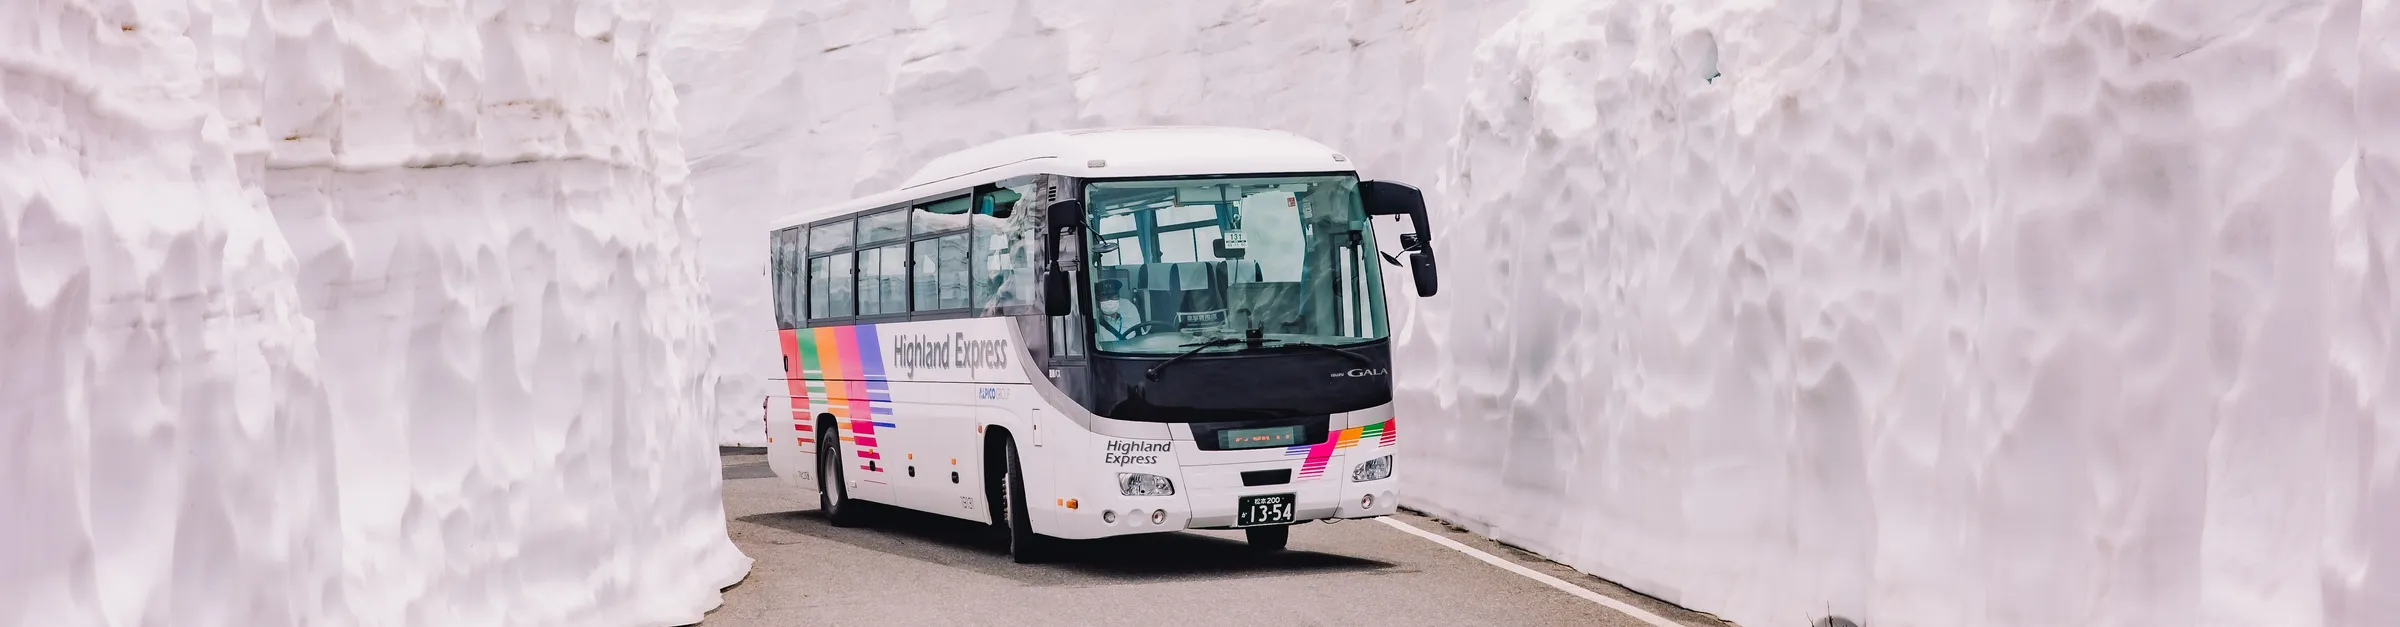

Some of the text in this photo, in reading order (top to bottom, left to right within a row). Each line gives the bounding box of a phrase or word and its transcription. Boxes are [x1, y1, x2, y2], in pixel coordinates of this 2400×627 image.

[894, 332, 1008, 380] Highland Express
[1347, 367, 1388, 377] GALA
[1107, 440, 1171, 455] Highland
[1105, 452, 1158, 467] Express
[1250, 503, 1292, 523] 13-54
